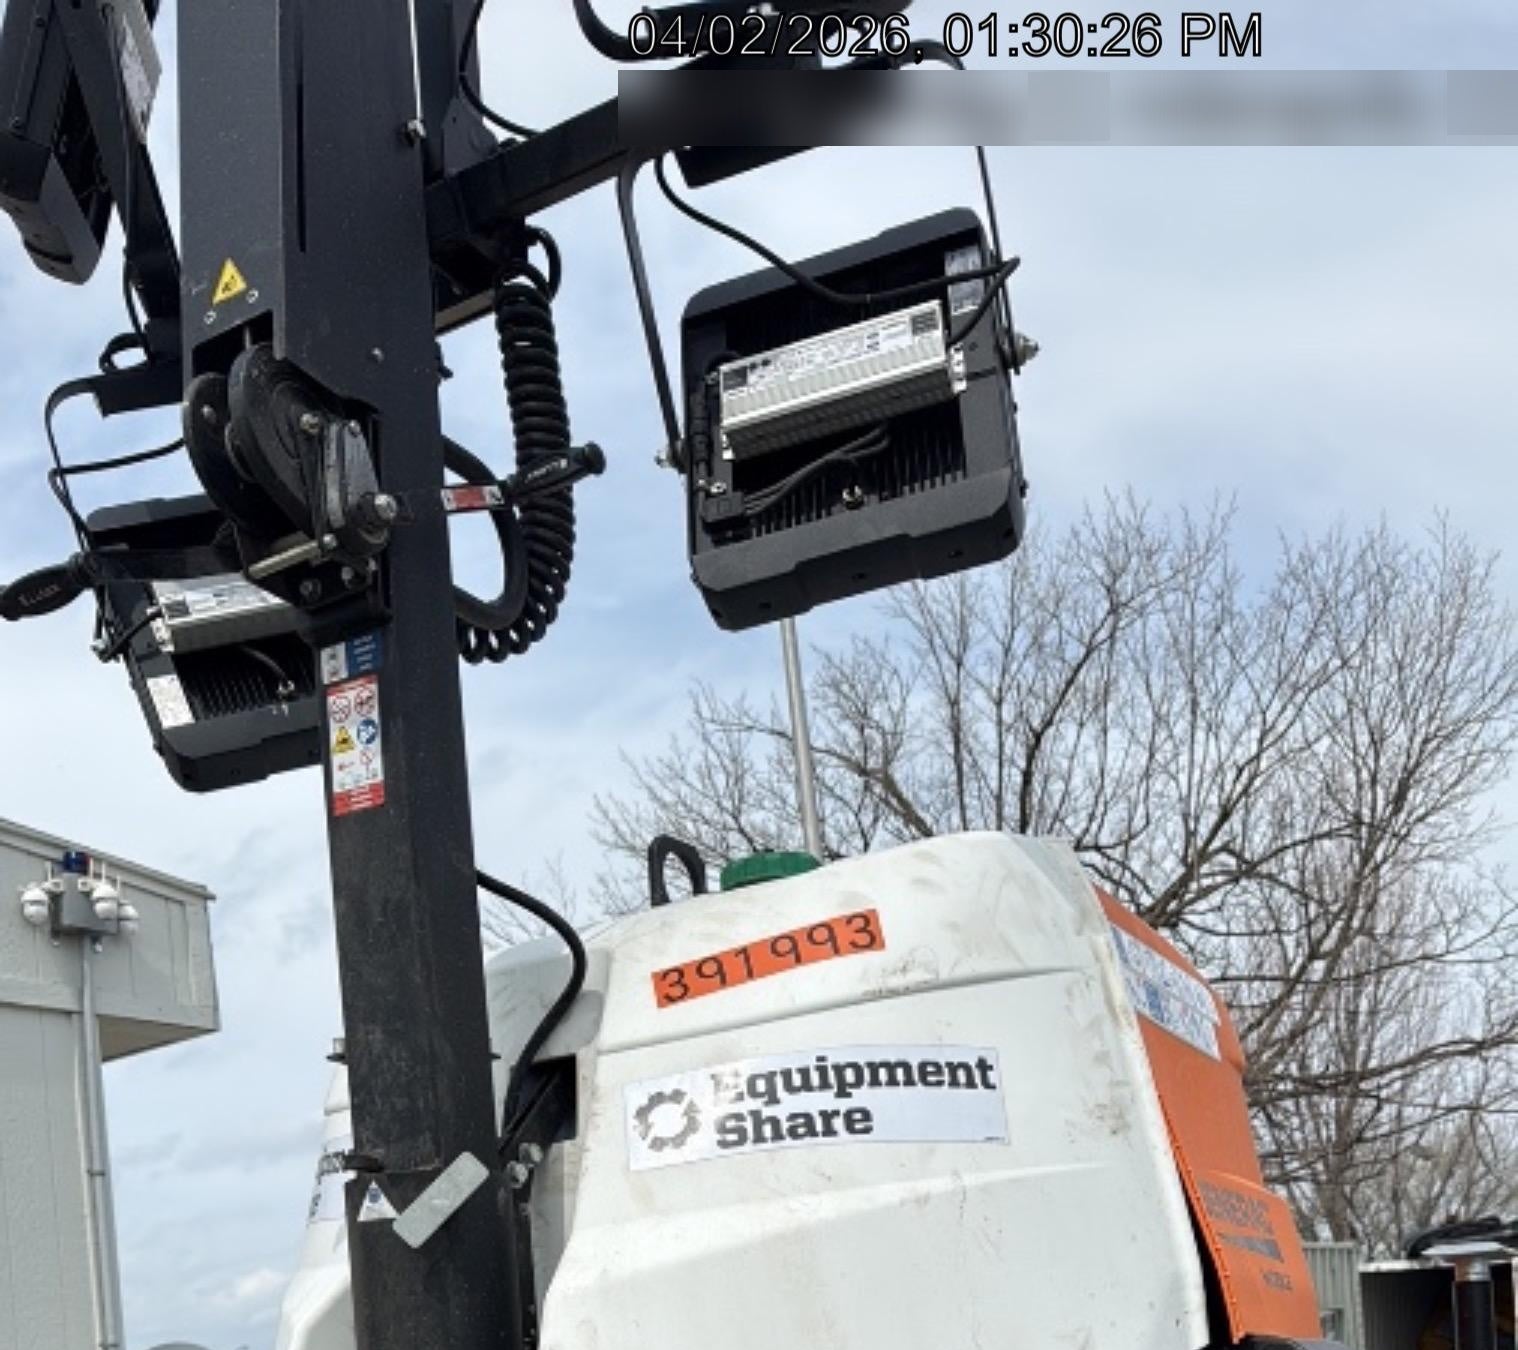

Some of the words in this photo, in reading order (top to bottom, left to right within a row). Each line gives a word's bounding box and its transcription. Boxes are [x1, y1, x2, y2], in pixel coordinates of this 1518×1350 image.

[660, 914, 879, 1003] 391993
[710, 1056, 998, 1106] Equipment
[714, 1106, 874, 1150] Share
